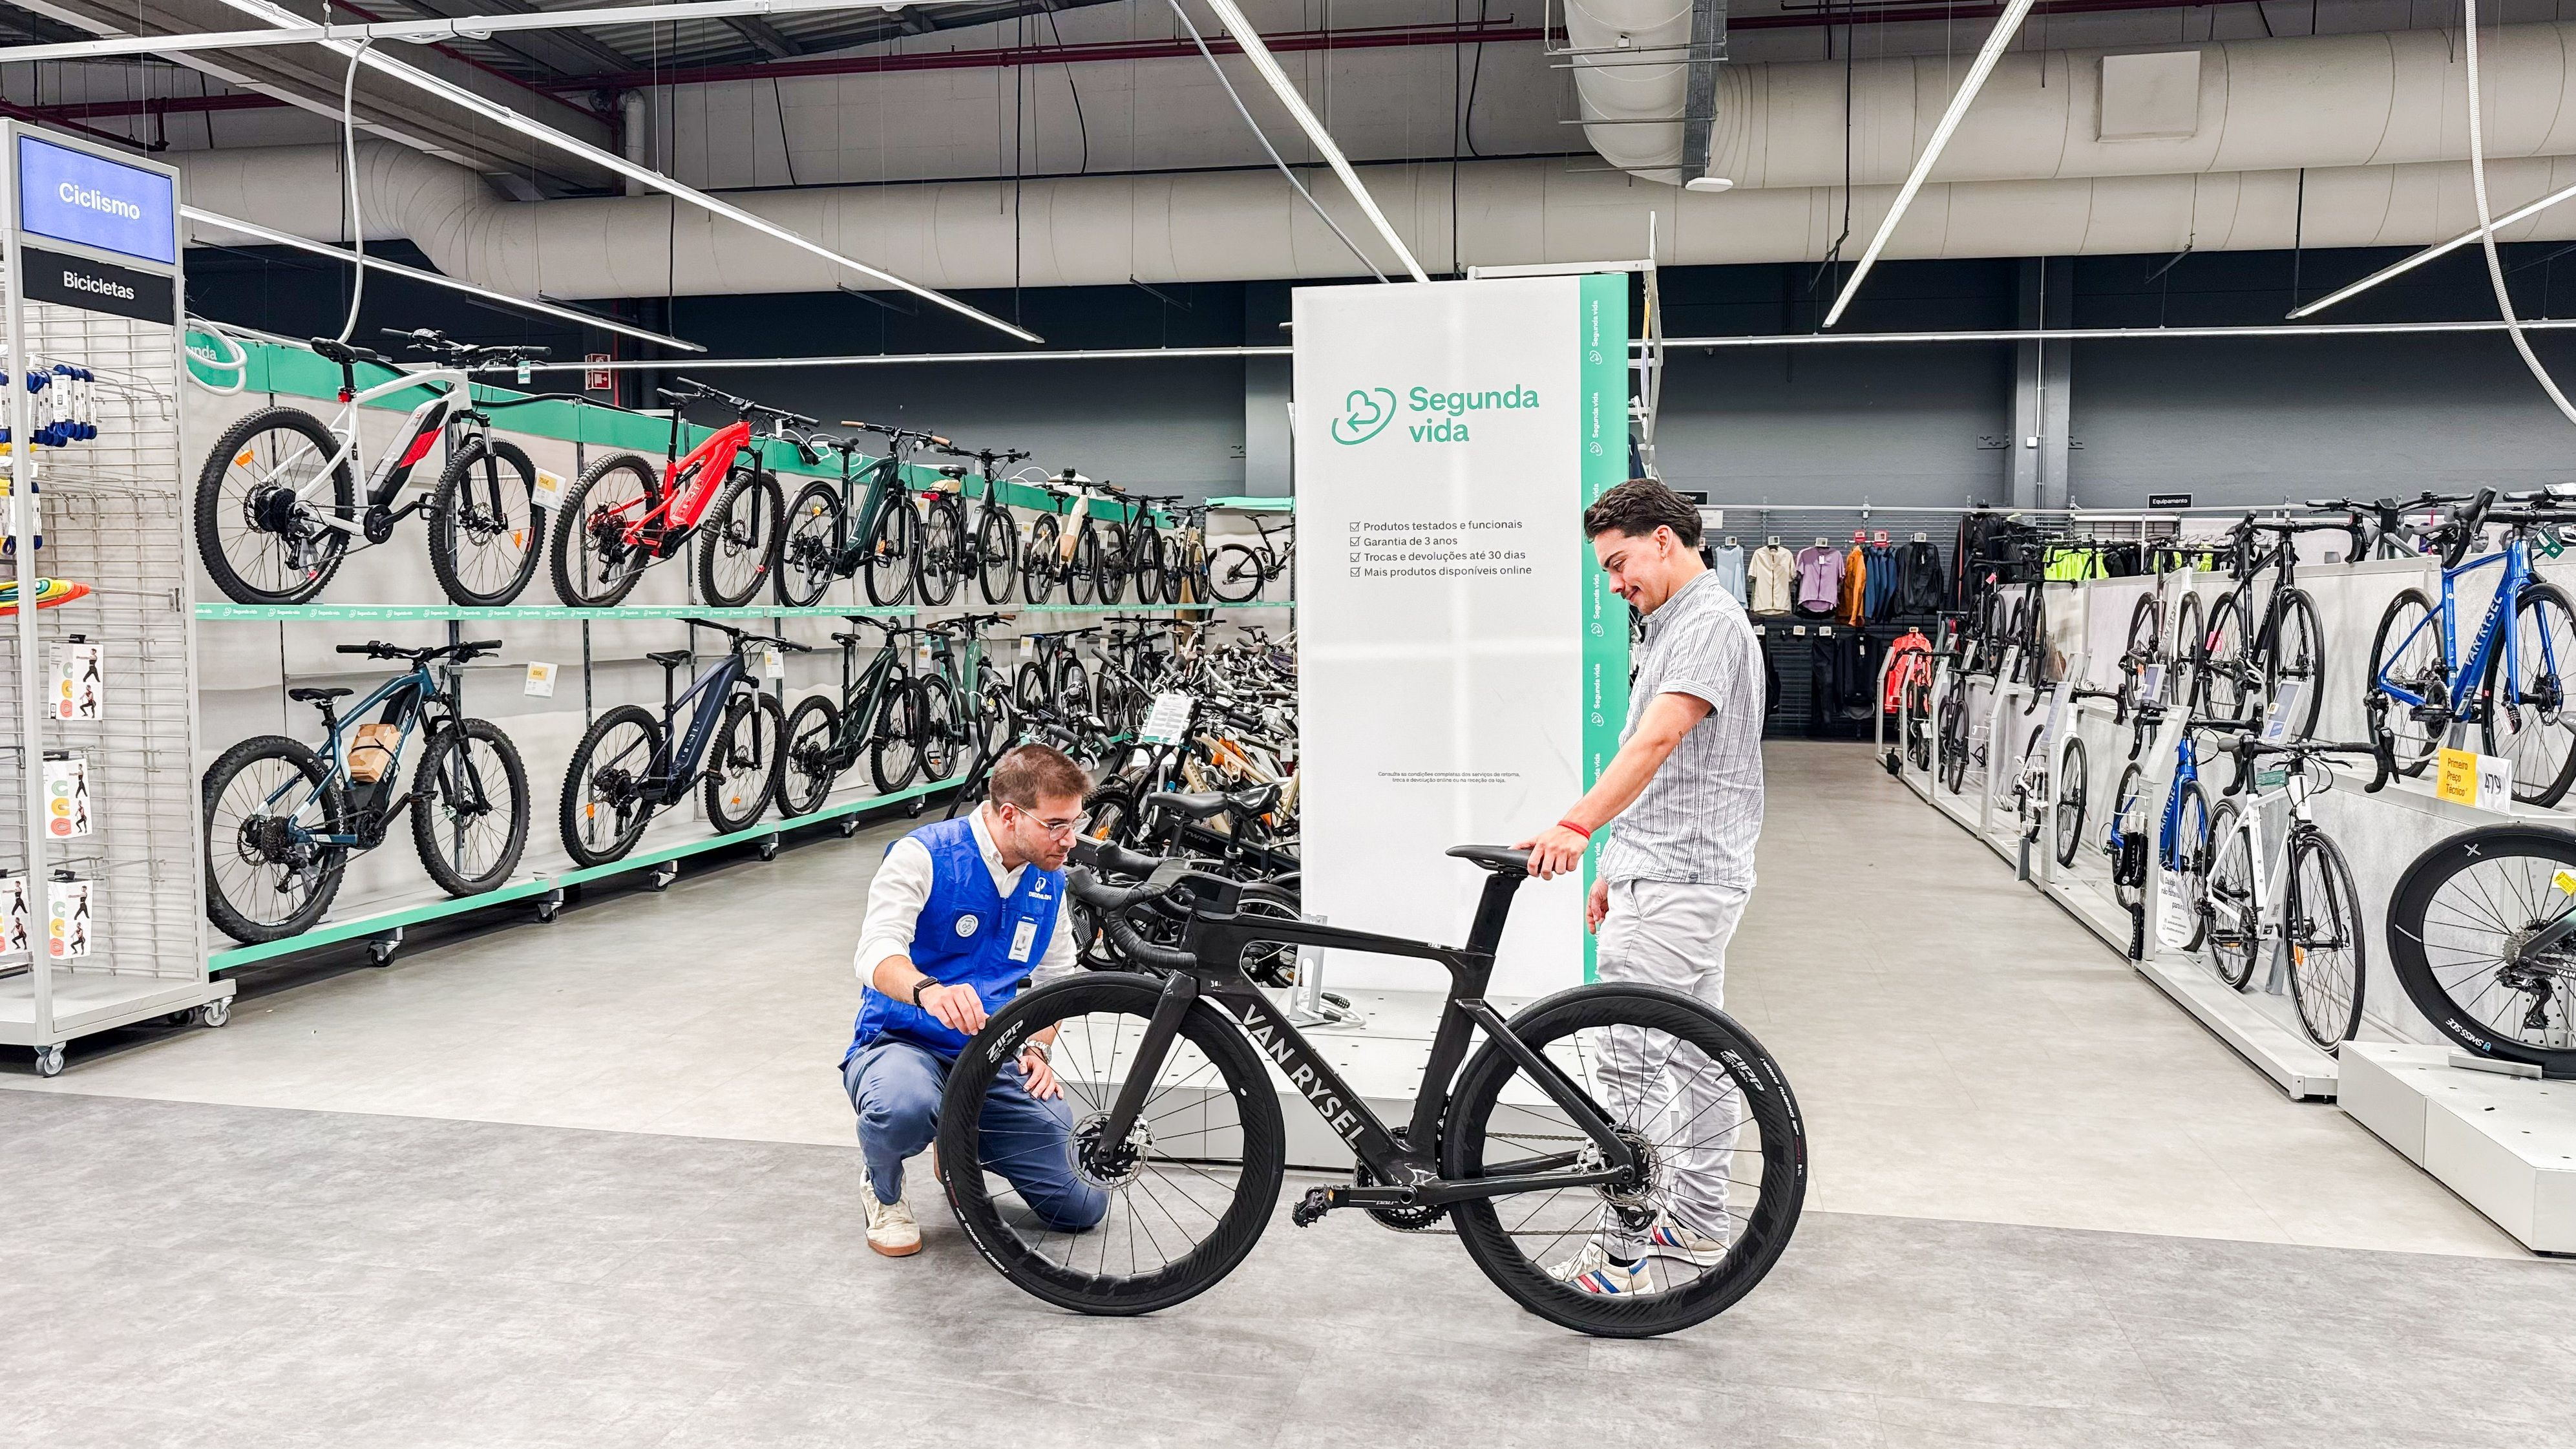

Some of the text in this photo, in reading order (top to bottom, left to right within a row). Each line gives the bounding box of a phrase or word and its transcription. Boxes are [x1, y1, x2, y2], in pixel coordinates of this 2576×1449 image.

[59, 183, 140, 220] Ciclismo
[64, 271, 134, 299] Bicicletas
[1409, 384, 1539, 416] Segunda
[1409, 418, 1470, 442] vida
[1364, 522, 1409, 531] Produtos
[1412, 521, 1457, 530] testados
[1468, 520, 1523, 529] funcionais
[1364, 537, 1407, 546] Garantia
[1409, 537, 1422, 545] de
[1408, 551, 1467, 562] devoluções
[1470, 551, 1486, 560] até
[1488, 551, 1501, 560] 30
[1504, 550, 1526, 559] dias
[1364, 565, 1532, 578] Mais produtos disponíveis online
[2465, 596, 2503, 666] VAN RYSEL
[2447, 757, 2468, 770] Primeiro
[2447, 770, 2462, 784] Preço
[311, 762, 341, 805] HUTCNSON
[1028, 891, 1052, 901] DECATHLON
[986, 1019, 1023, 1060] ZIPP
[2445, 1017, 2484, 1047] SWISS SIDE
[1243, 1004, 1365, 1150] VAN RYSEL
[1724, 1049, 1765, 1091] ZIPP
[1778, 1086, 1795, 1119] RUBINO
